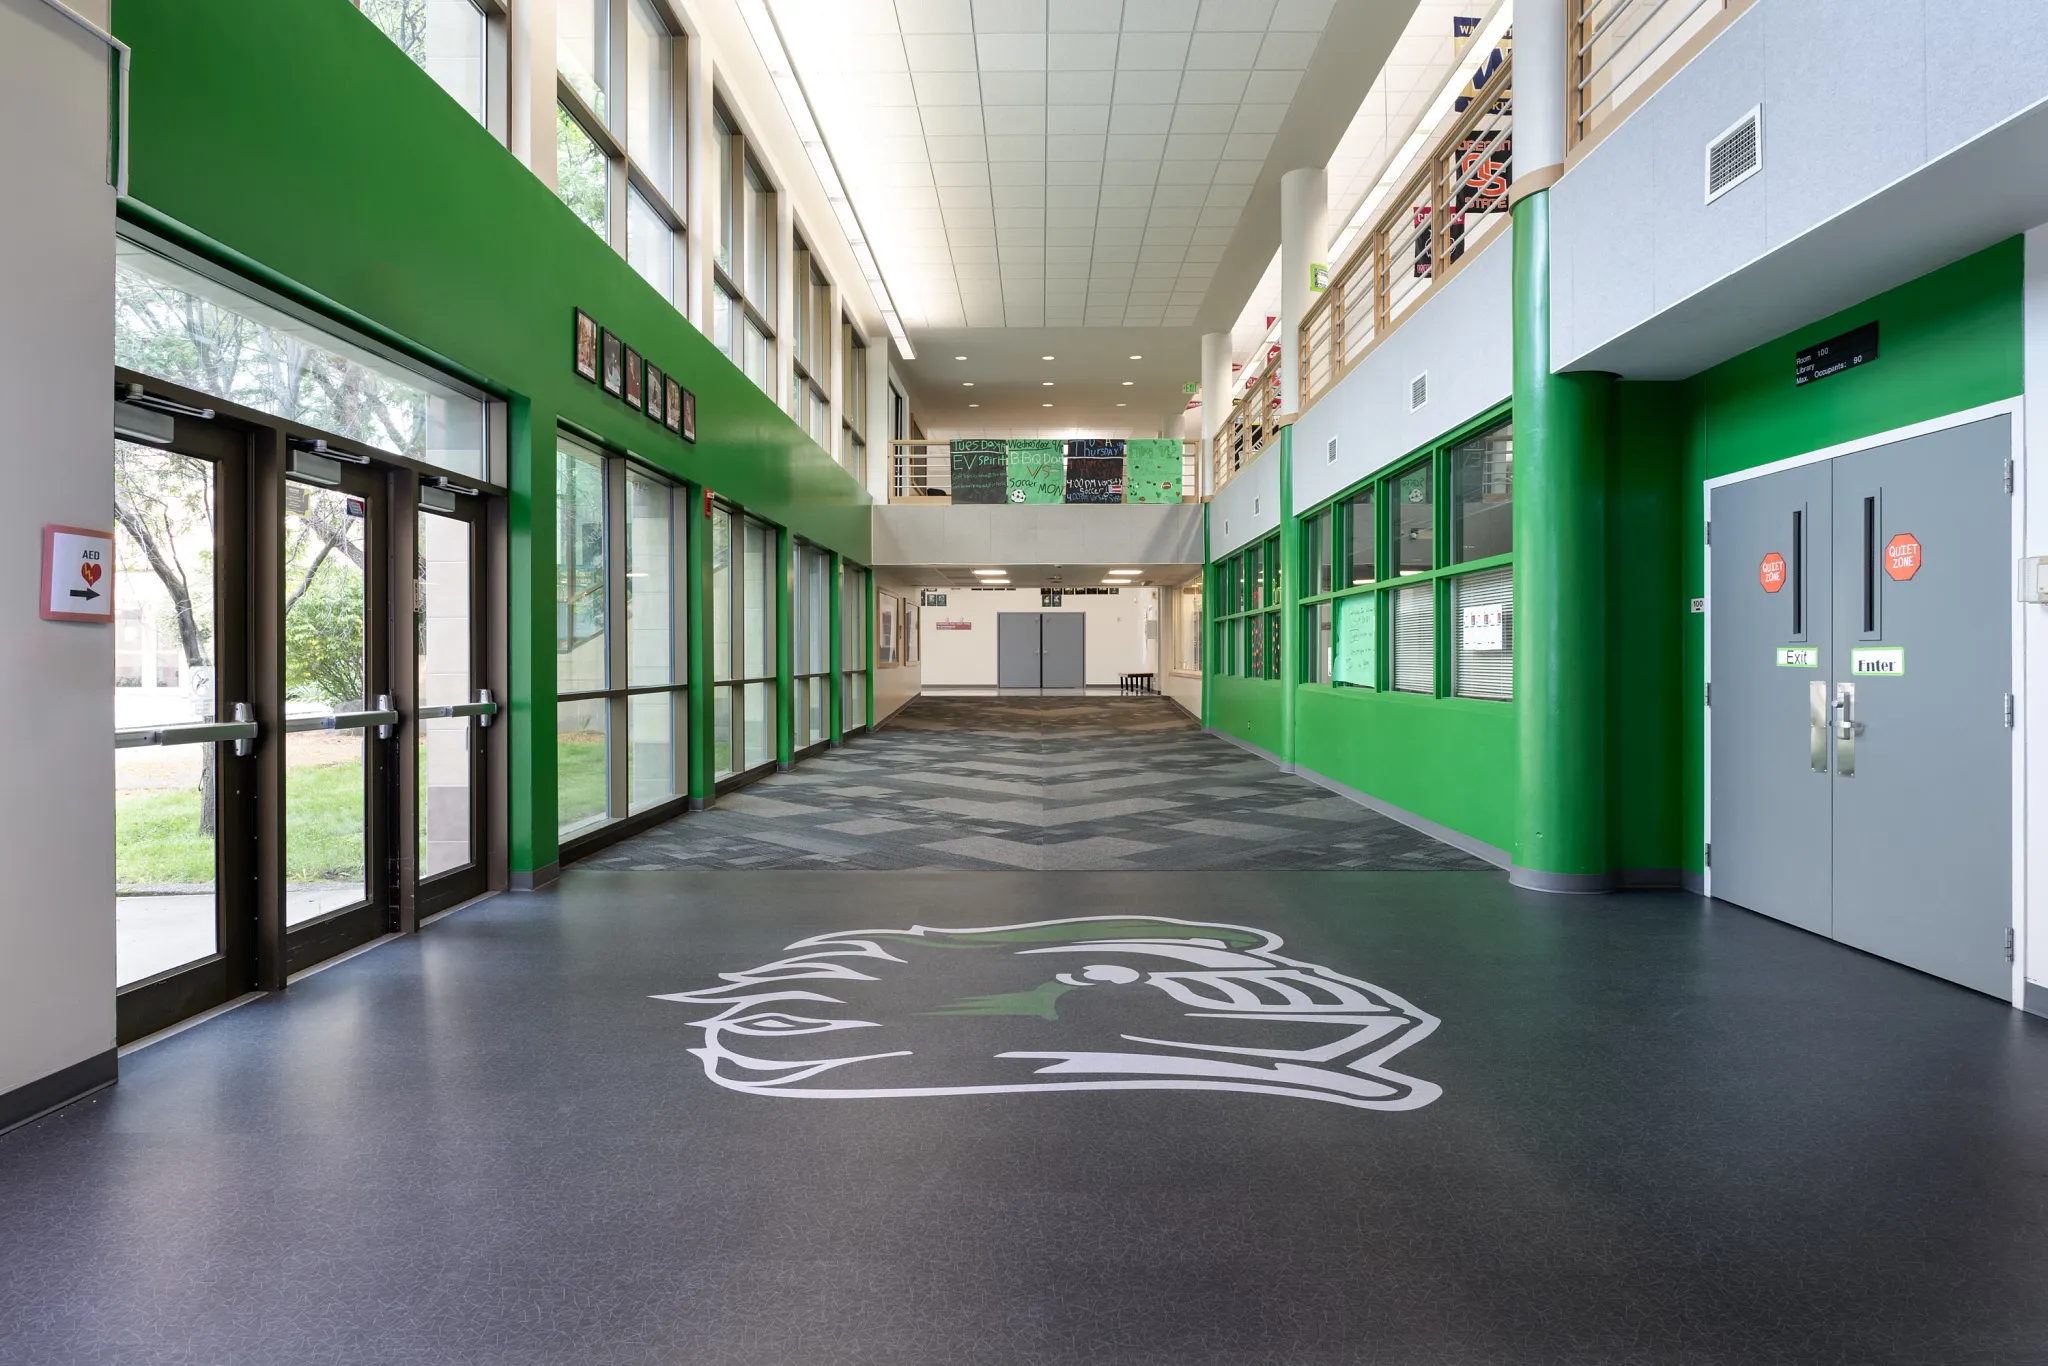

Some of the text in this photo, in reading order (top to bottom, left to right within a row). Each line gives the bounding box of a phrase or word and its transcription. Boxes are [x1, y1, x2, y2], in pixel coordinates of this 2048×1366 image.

[1796, 347, 1829, 365] Room 100
[1853, 355, 1863, 364] 90
[1796, 363, 1815, 375] Library
[82, 550, 100, 560] AED
[1889, 543, 1918, 557] QUIET
[1762, 561, 1783, 573] QUIET
[1892, 556, 1914, 568] ZONE
[1765, 572, 1781, 582] ZONE
[1693, 600, 1703, 608] 100
[1787, 650, 1807, 664] Exit
[1858, 659, 1896, 672] Enter
